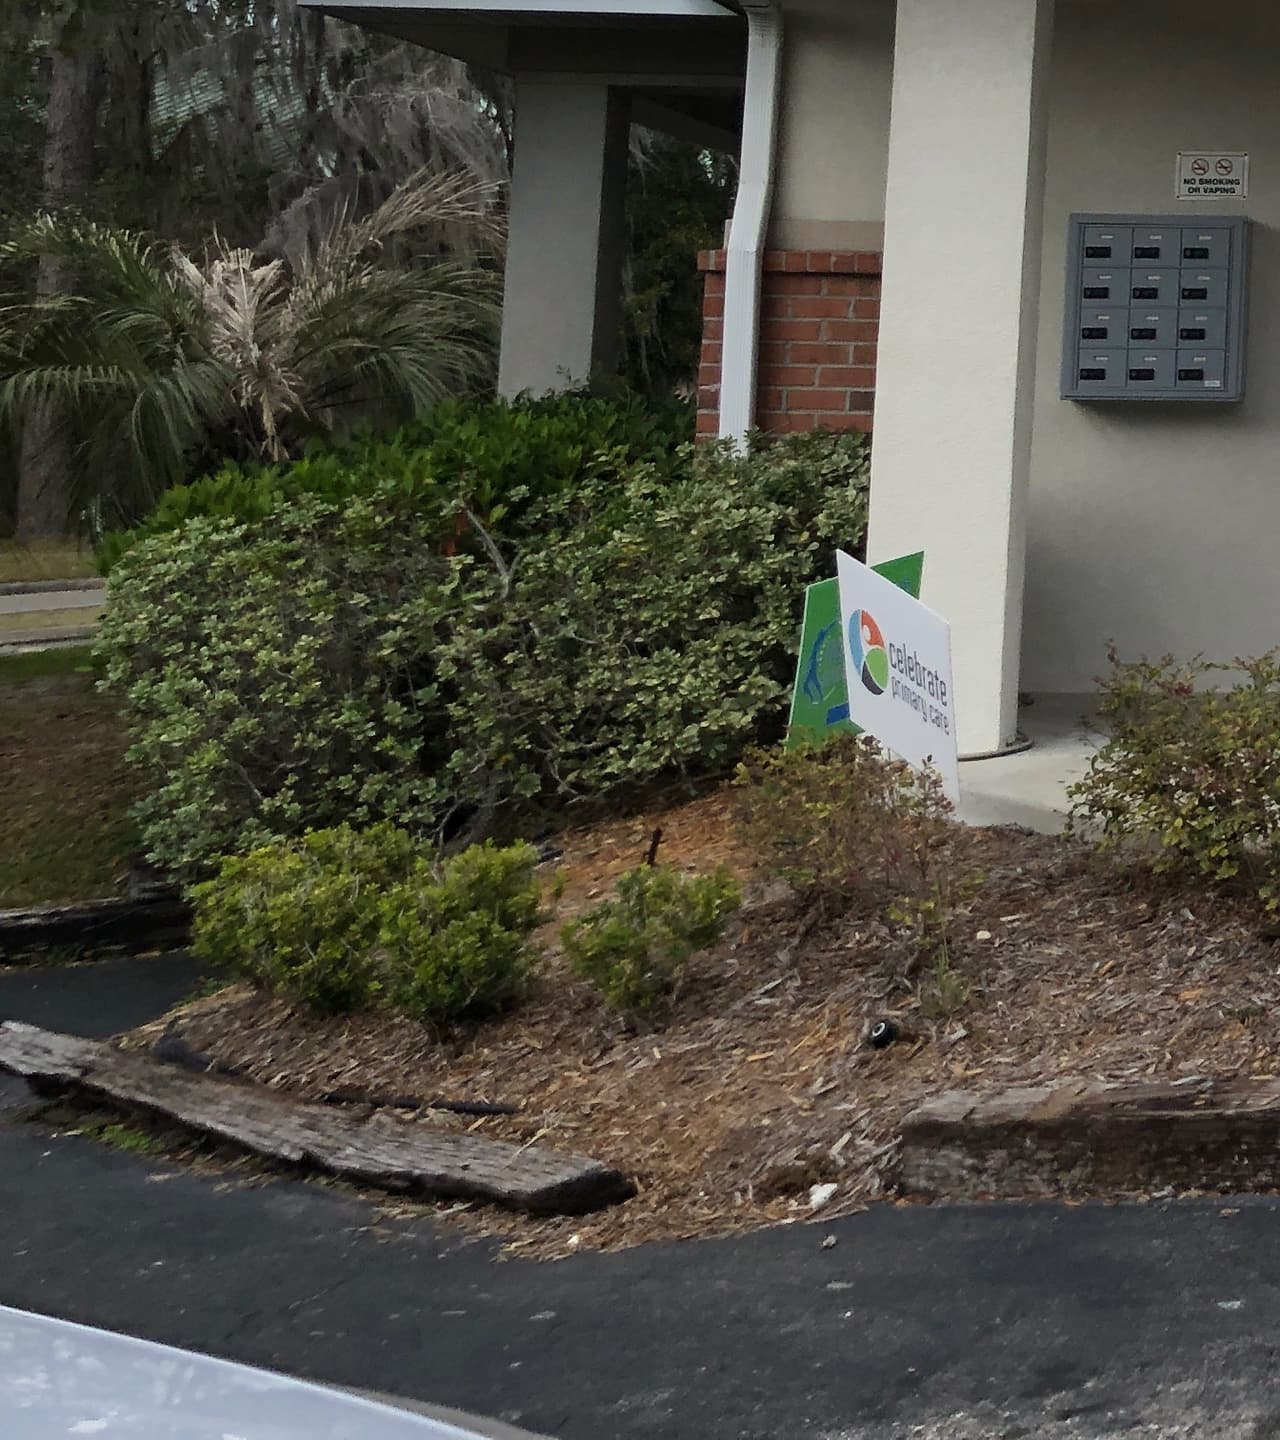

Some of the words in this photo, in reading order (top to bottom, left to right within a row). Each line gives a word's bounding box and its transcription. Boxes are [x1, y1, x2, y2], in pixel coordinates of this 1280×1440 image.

[1198, 178, 1241, 186] SMOKING
[889, 642, 948, 707] celebrate
[891, 675, 928, 723] primary
[929, 703, 950, 736] care
